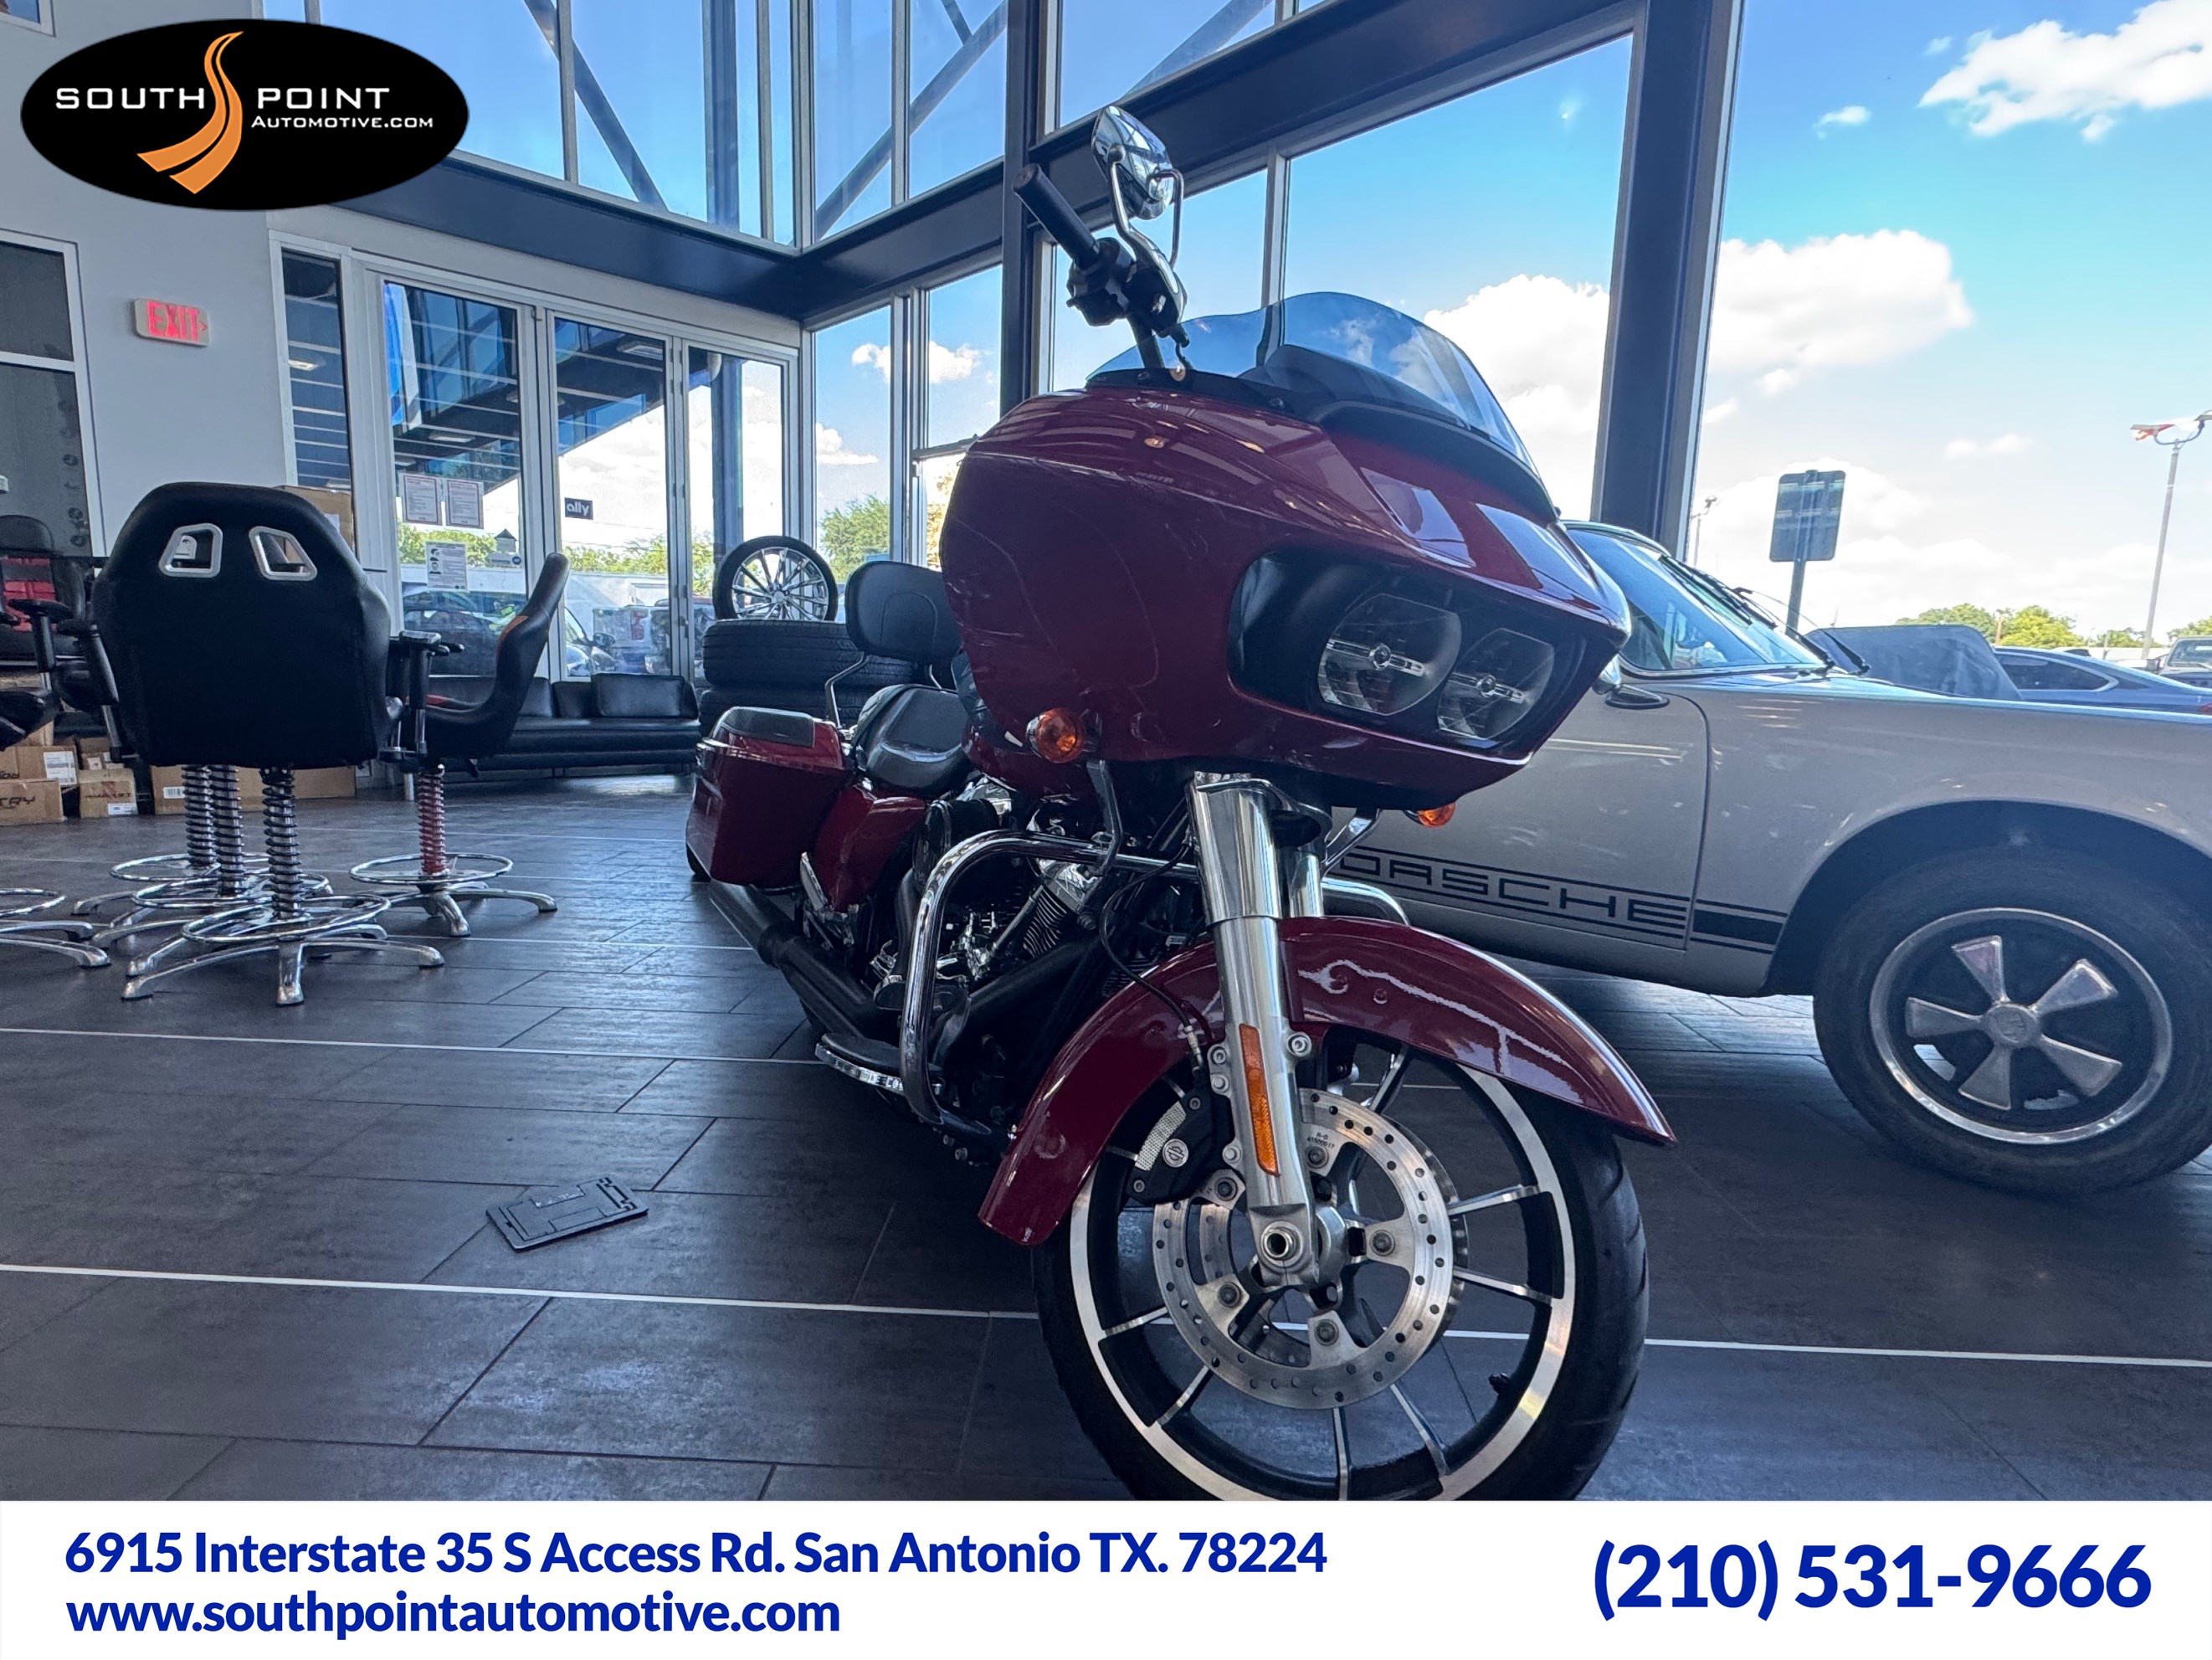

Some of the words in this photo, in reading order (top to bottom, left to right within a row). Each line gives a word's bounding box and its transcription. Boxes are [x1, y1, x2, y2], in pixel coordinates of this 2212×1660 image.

[146, 300, 199, 342] EXIT
[566, 501, 590, 517] ally
[1339, 851, 1686, 928] ORSCHE
